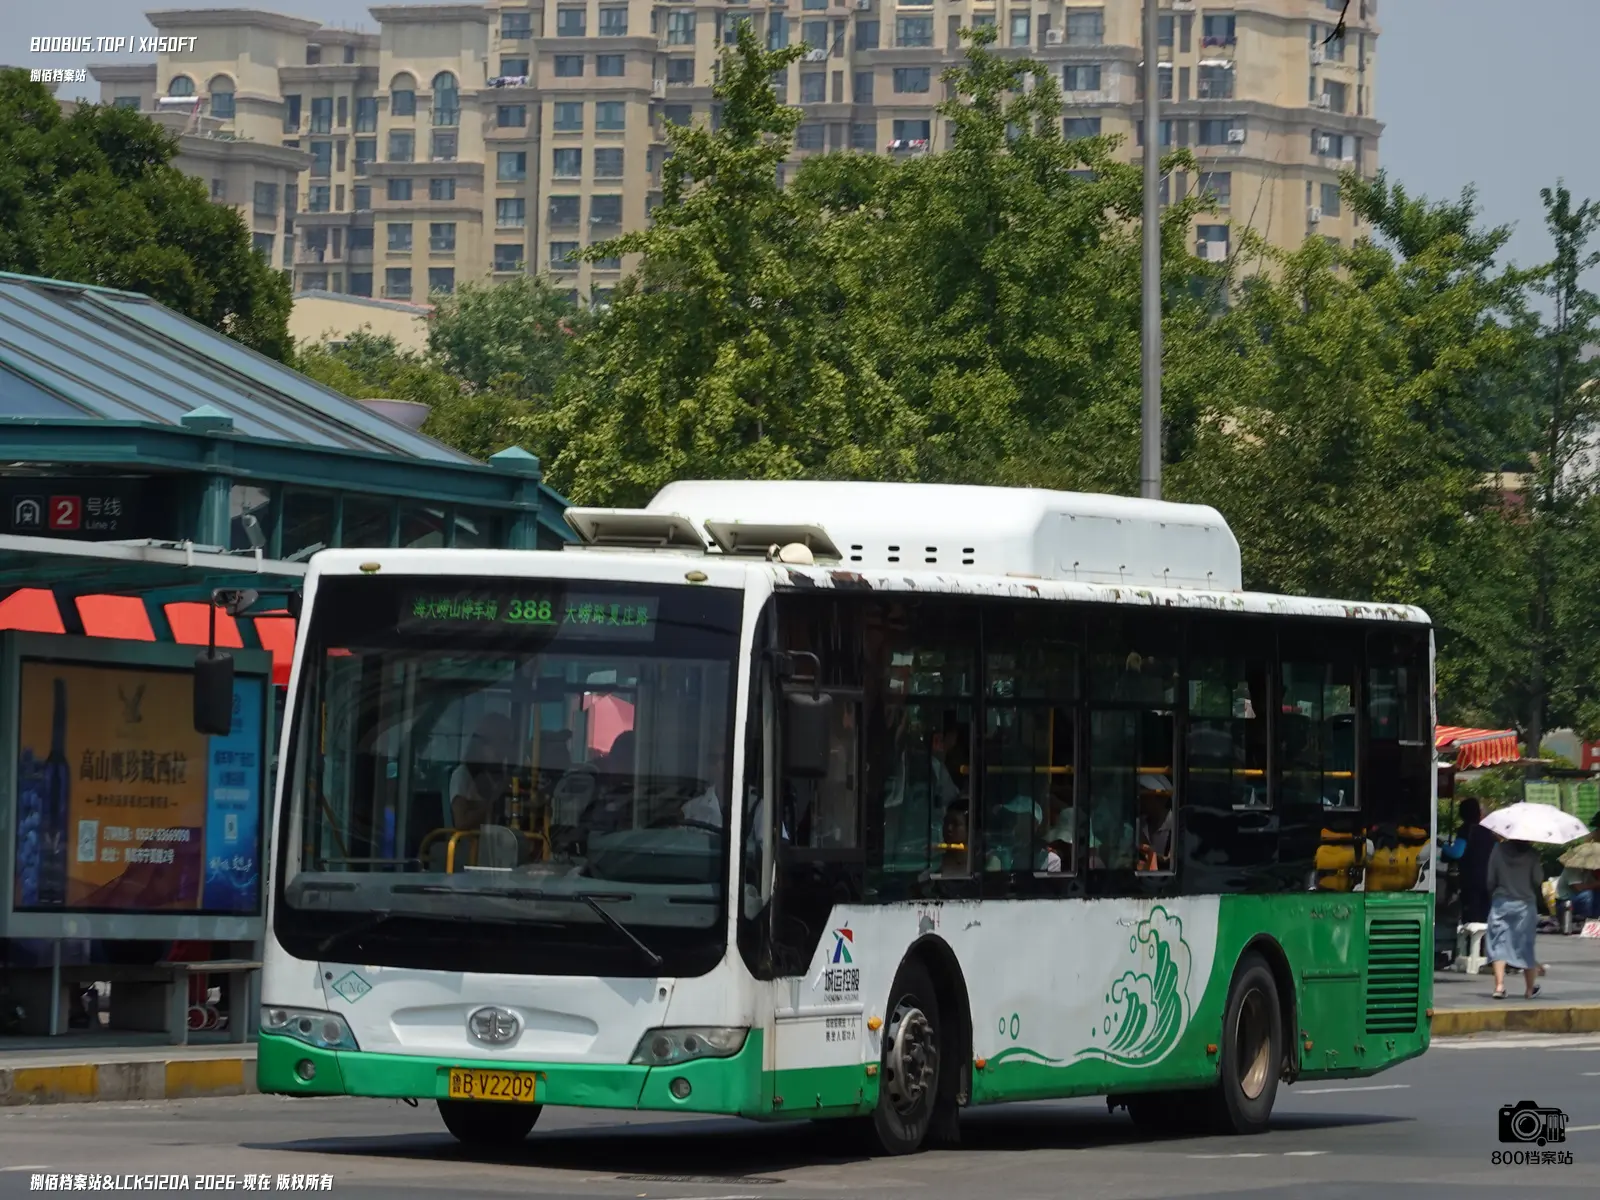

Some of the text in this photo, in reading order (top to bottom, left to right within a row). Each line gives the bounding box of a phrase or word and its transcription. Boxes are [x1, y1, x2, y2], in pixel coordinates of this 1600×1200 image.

[56, 497, 122, 525] 2 号线
[86, 520, 118, 530] Line 2
[508, 599, 553, 621] 388
[339, 981, 366, 994] CNG
[824, 968, 860, 993] 城运控股
